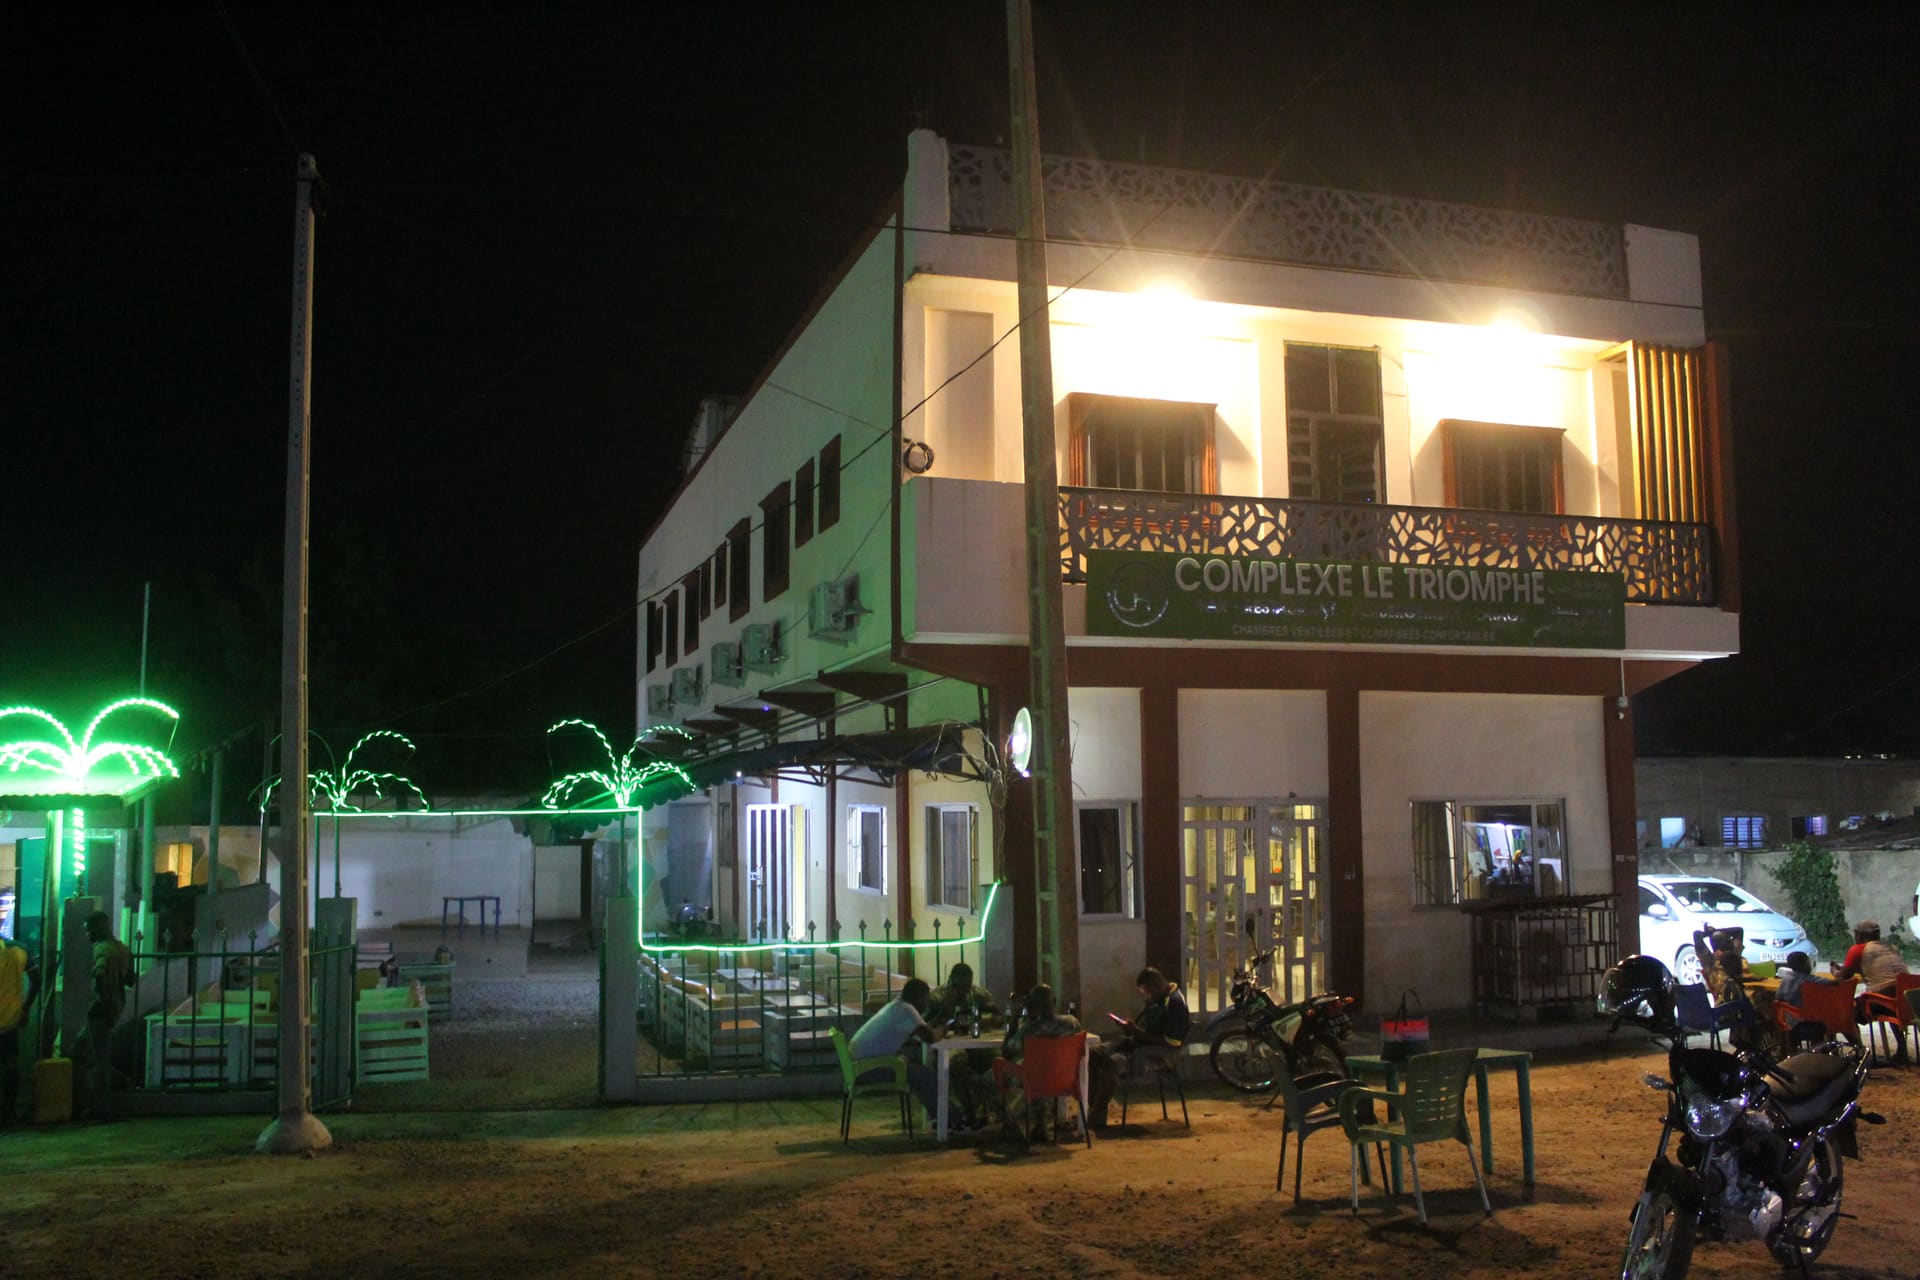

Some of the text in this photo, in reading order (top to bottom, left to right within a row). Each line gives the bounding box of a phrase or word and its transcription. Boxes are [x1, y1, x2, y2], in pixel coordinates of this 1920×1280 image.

[1175, 557, 1352, 597] COMPLEXE
[1362, 565, 1393, 599] LE
[1404, 567, 1545, 605] TRIOMPHE
[1232, 623, 1288, 638] CHAMBRES
